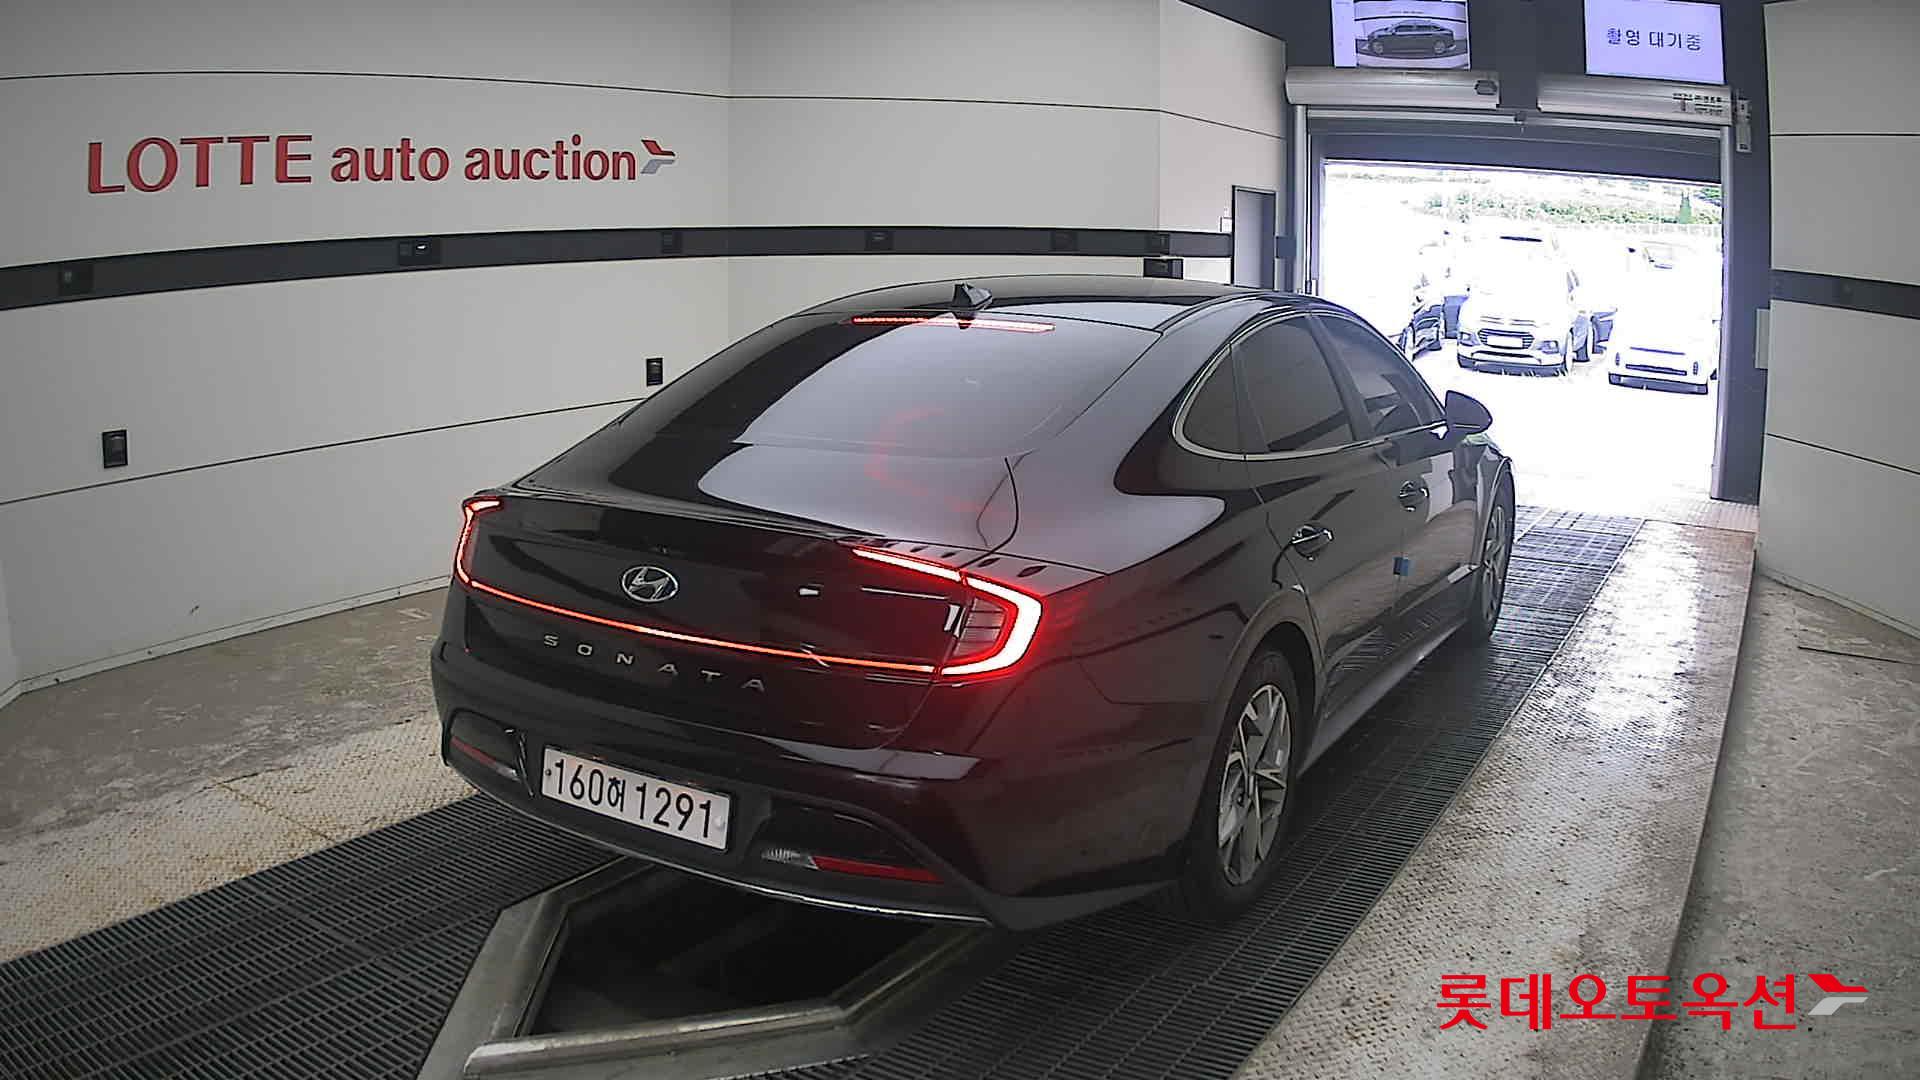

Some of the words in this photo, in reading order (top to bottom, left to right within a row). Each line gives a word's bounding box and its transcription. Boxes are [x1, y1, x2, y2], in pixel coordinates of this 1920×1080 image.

[1607, 27, 1641, 47] 촬영
[1648, 31, 1701, 52] 대기중
[87, 134, 313, 195] LOTTE
[330, 137, 450, 183] auto
[463, 133, 637, 182] auction
[543, 633, 766, 693] SONATA
